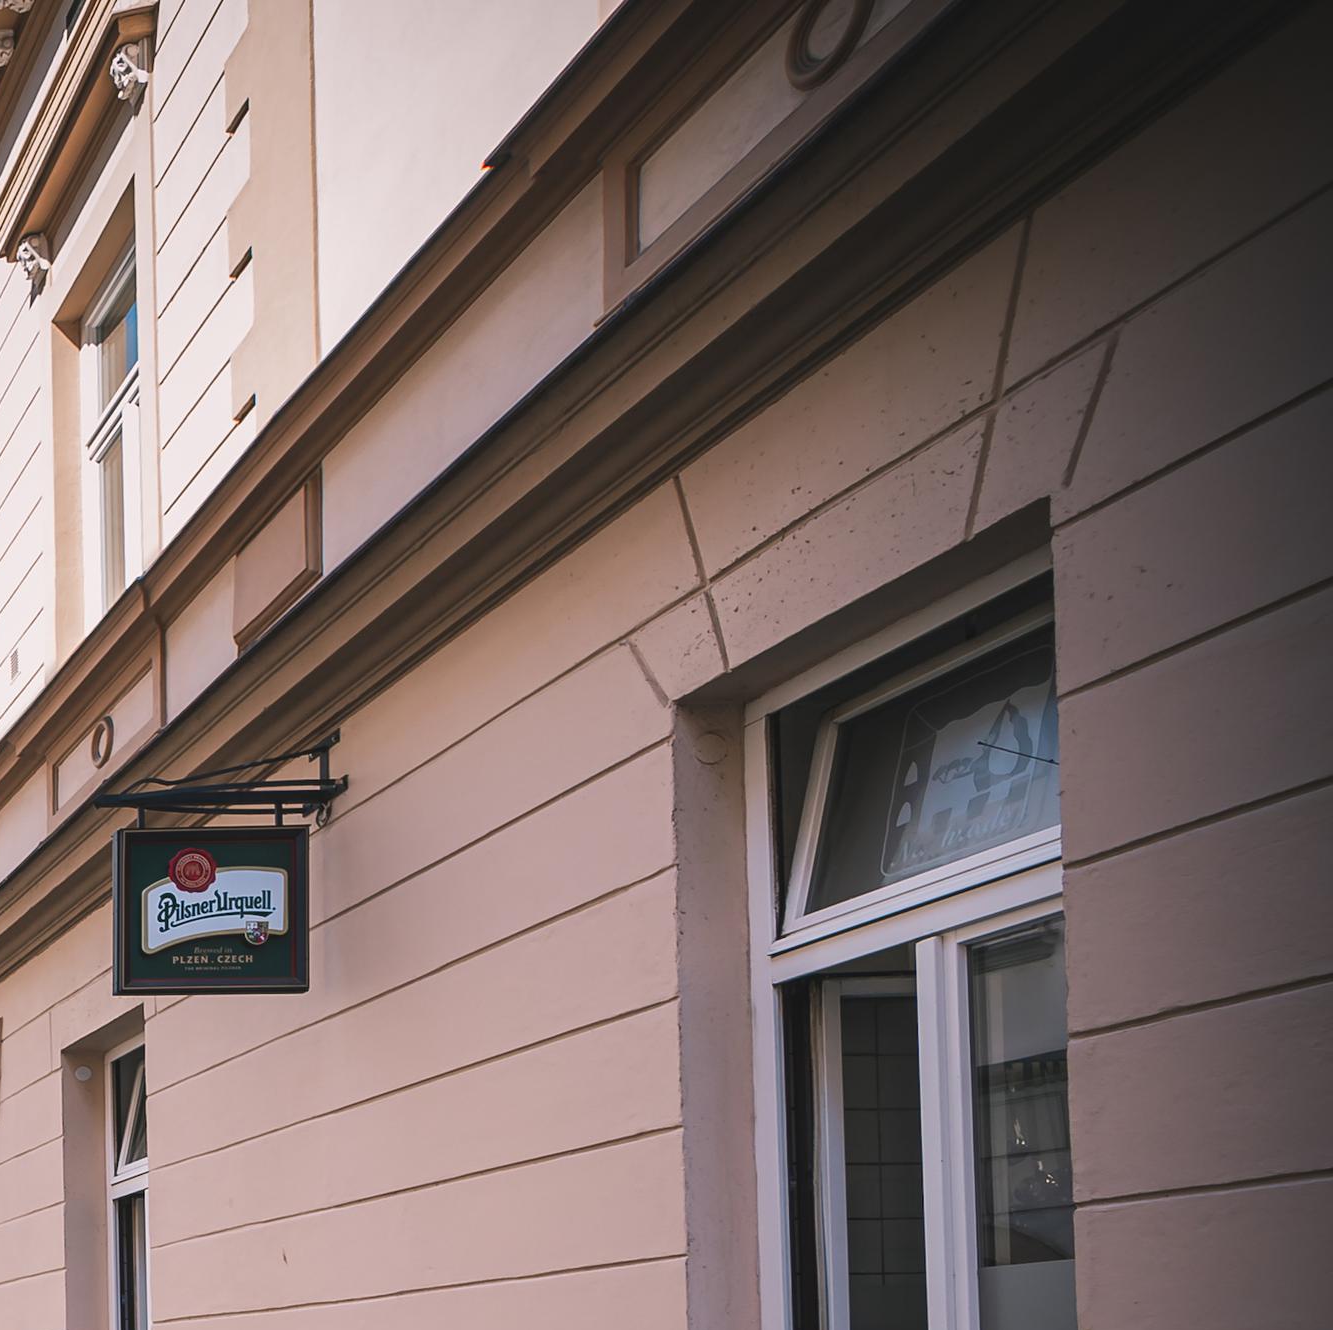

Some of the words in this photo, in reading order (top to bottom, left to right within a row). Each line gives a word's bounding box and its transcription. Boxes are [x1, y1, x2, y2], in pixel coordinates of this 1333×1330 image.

[157, 892, 217, 933] Pilsner
[172, 955, 209, 964] PLZEN
[217, 955, 253, 963] CZECH
